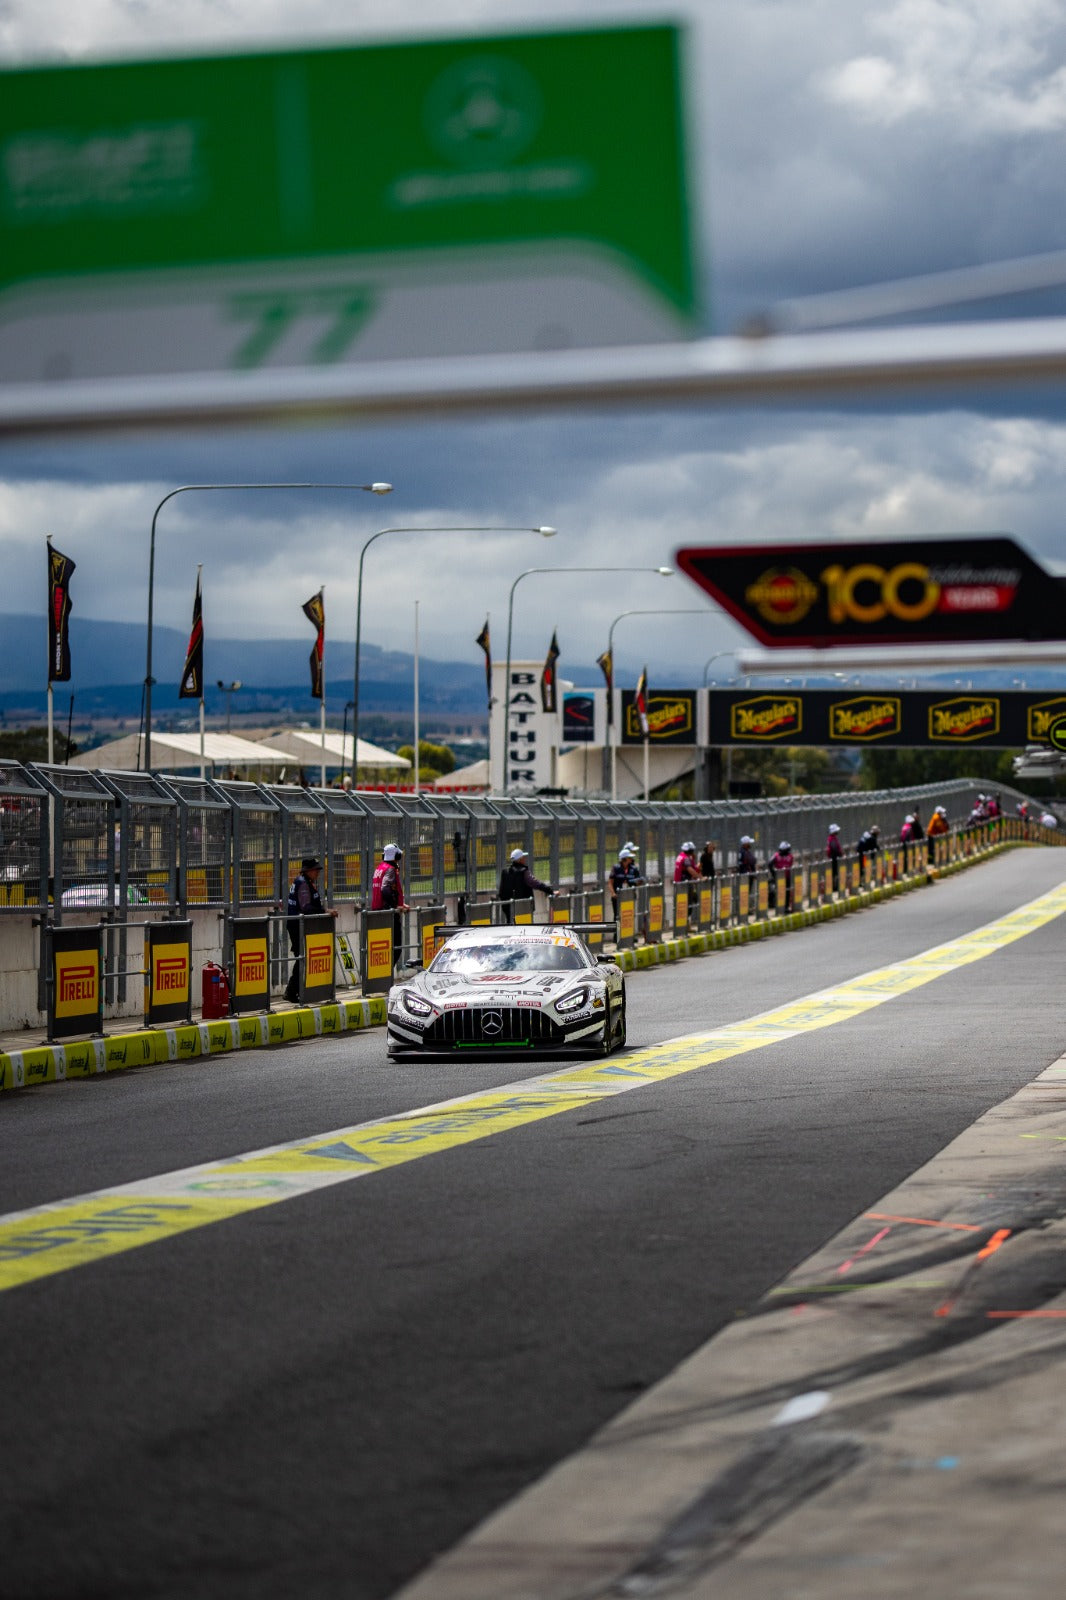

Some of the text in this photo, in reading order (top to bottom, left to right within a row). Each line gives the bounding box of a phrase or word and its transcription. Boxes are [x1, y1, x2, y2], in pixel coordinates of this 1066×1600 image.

[227, 285, 378, 367] 77
[820, 562, 940, 624] 100
[370, 940, 390, 967] PIRELLI
[550, 936, 571, 946] 77
[156, 958, 187, 991] PIRELLI
[239, 952, 265, 982] PIRELLI
[308, 945, 331, 975] PIRELLI
[60, 966, 95, 1002] PIRELLI
